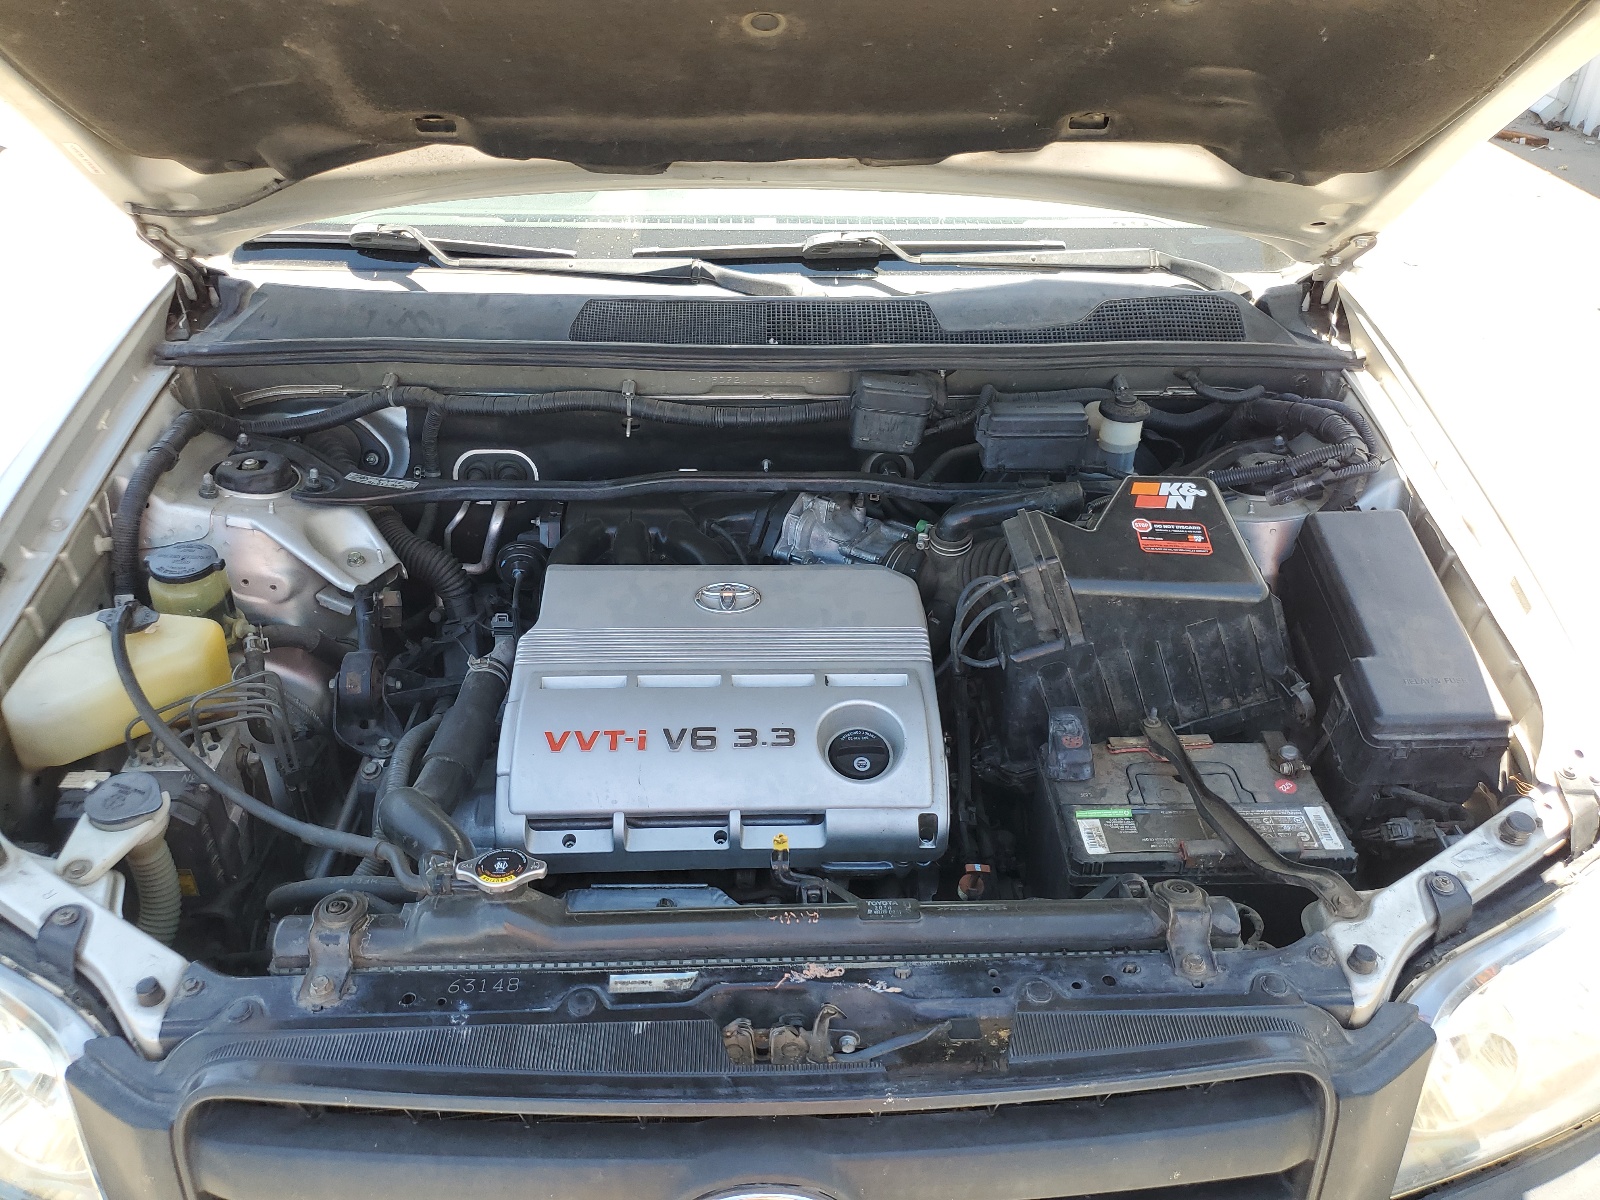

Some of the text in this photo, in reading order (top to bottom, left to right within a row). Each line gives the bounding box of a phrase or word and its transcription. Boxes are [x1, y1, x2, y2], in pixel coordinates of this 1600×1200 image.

[544, 726, 796, 752] VVT-i V6 3.3
[447, 977, 521, 993] 63148
